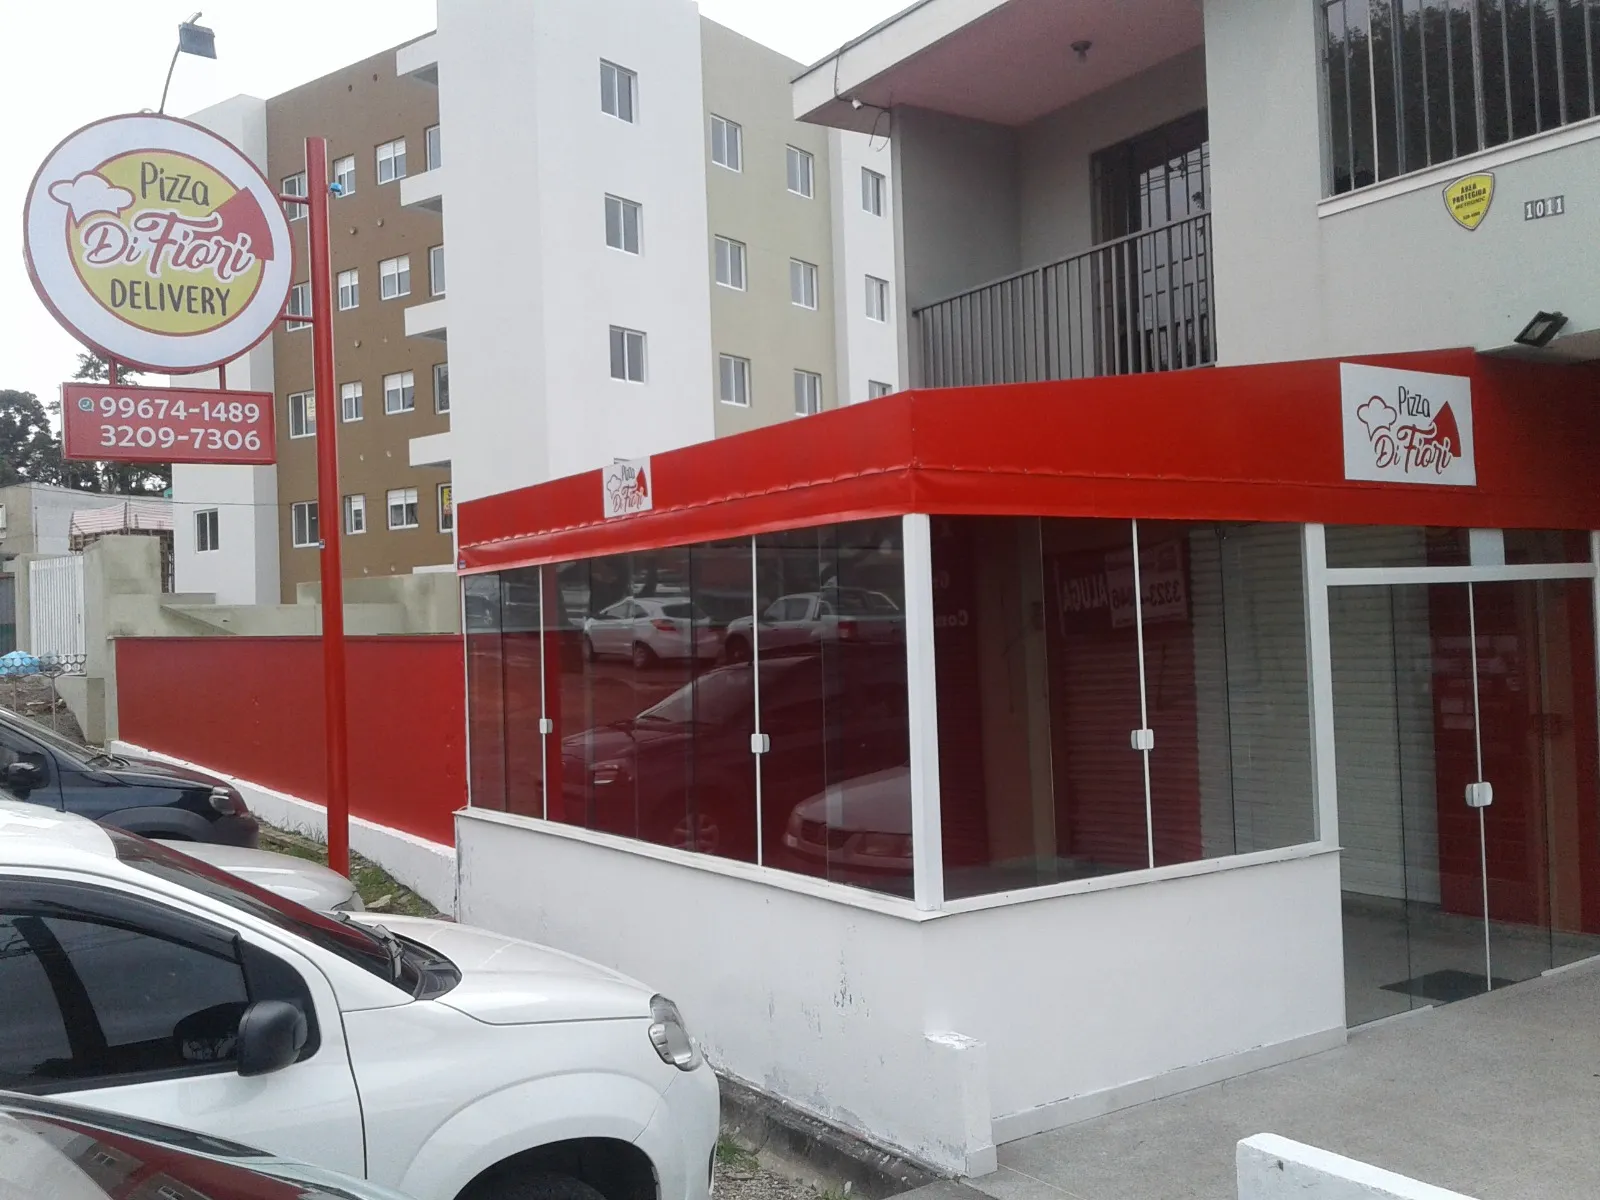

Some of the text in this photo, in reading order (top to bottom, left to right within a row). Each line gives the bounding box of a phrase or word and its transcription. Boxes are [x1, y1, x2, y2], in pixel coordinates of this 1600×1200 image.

[141, 161, 209, 207] Pizza
[1526, 197, 1563, 219] 1011
[84, 211, 252, 280] Di Fiori
[111, 278, 231, 317] DELIVERY
[100, 396, 260, 424] 99674-1489
[1398, 385, 1431, 418] Pizza
[100, 424, 261, 451] 3209-7306
[1374, 424, 1452, 475] Di Fiori
